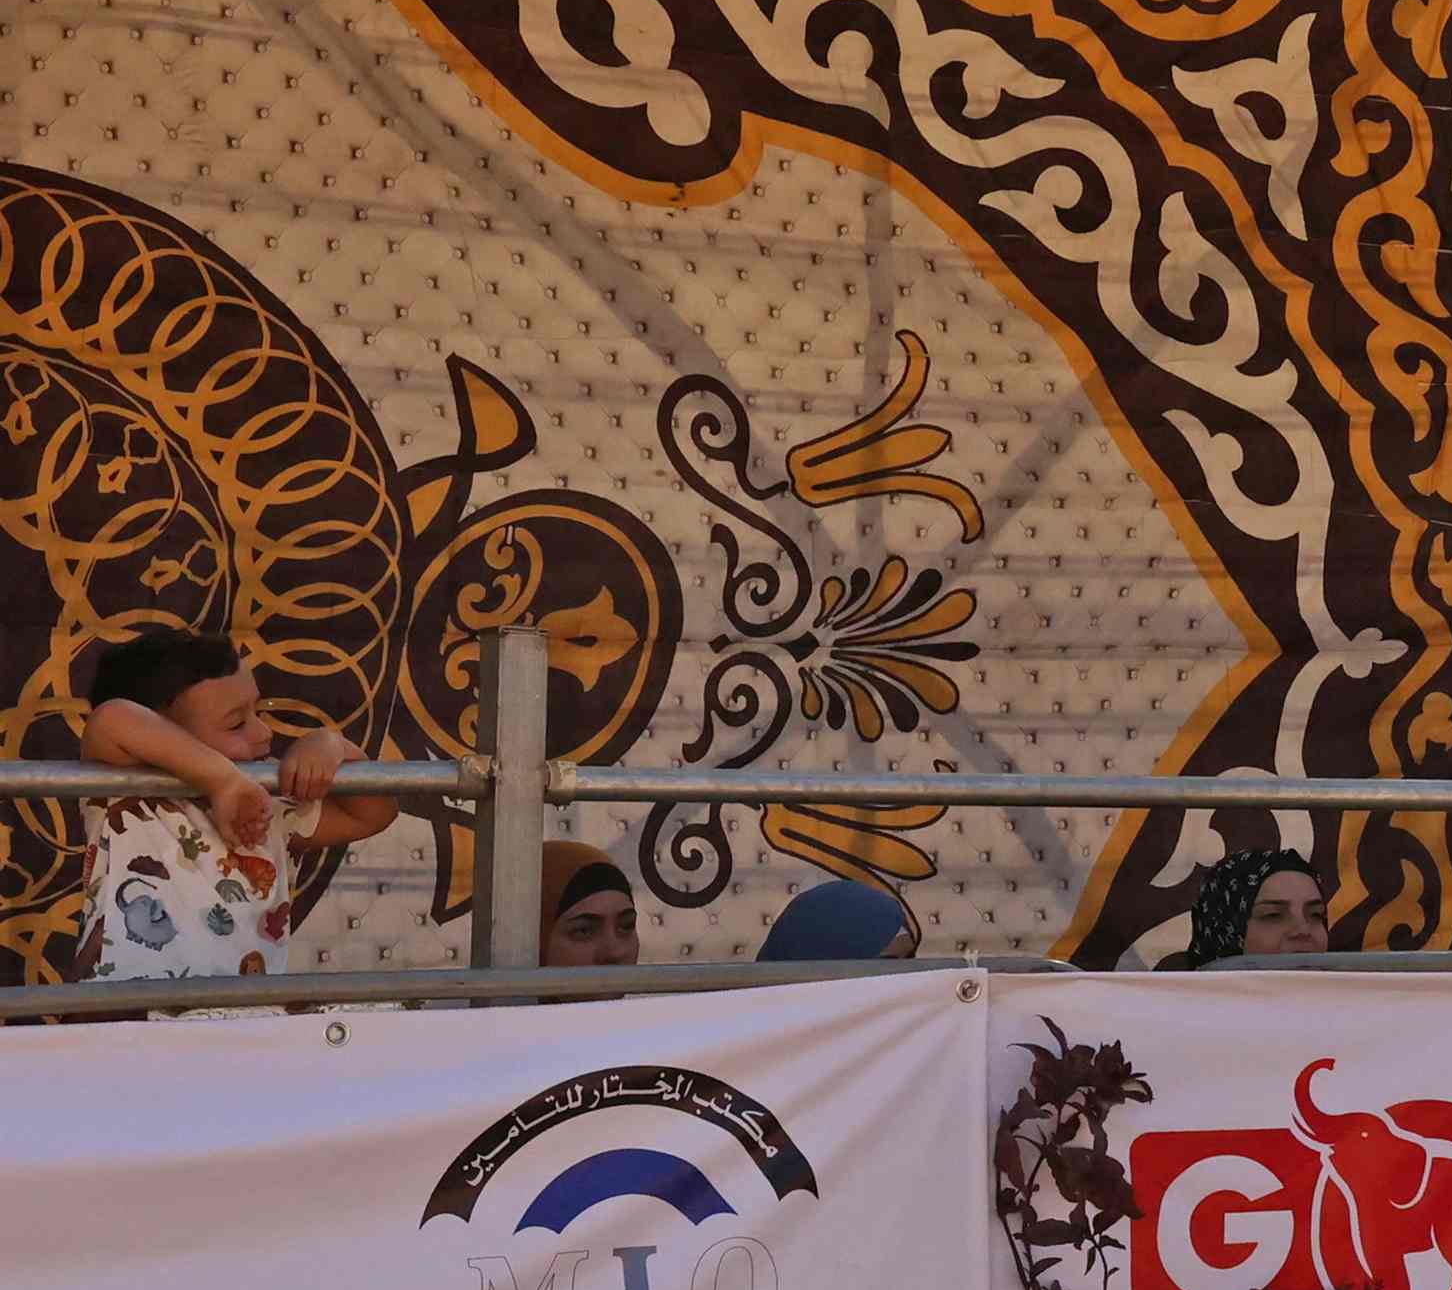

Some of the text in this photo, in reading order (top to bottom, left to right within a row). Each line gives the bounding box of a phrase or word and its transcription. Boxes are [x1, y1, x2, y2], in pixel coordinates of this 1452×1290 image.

[463, 1071, 779, 1187] مكتب المختار للتأمين
